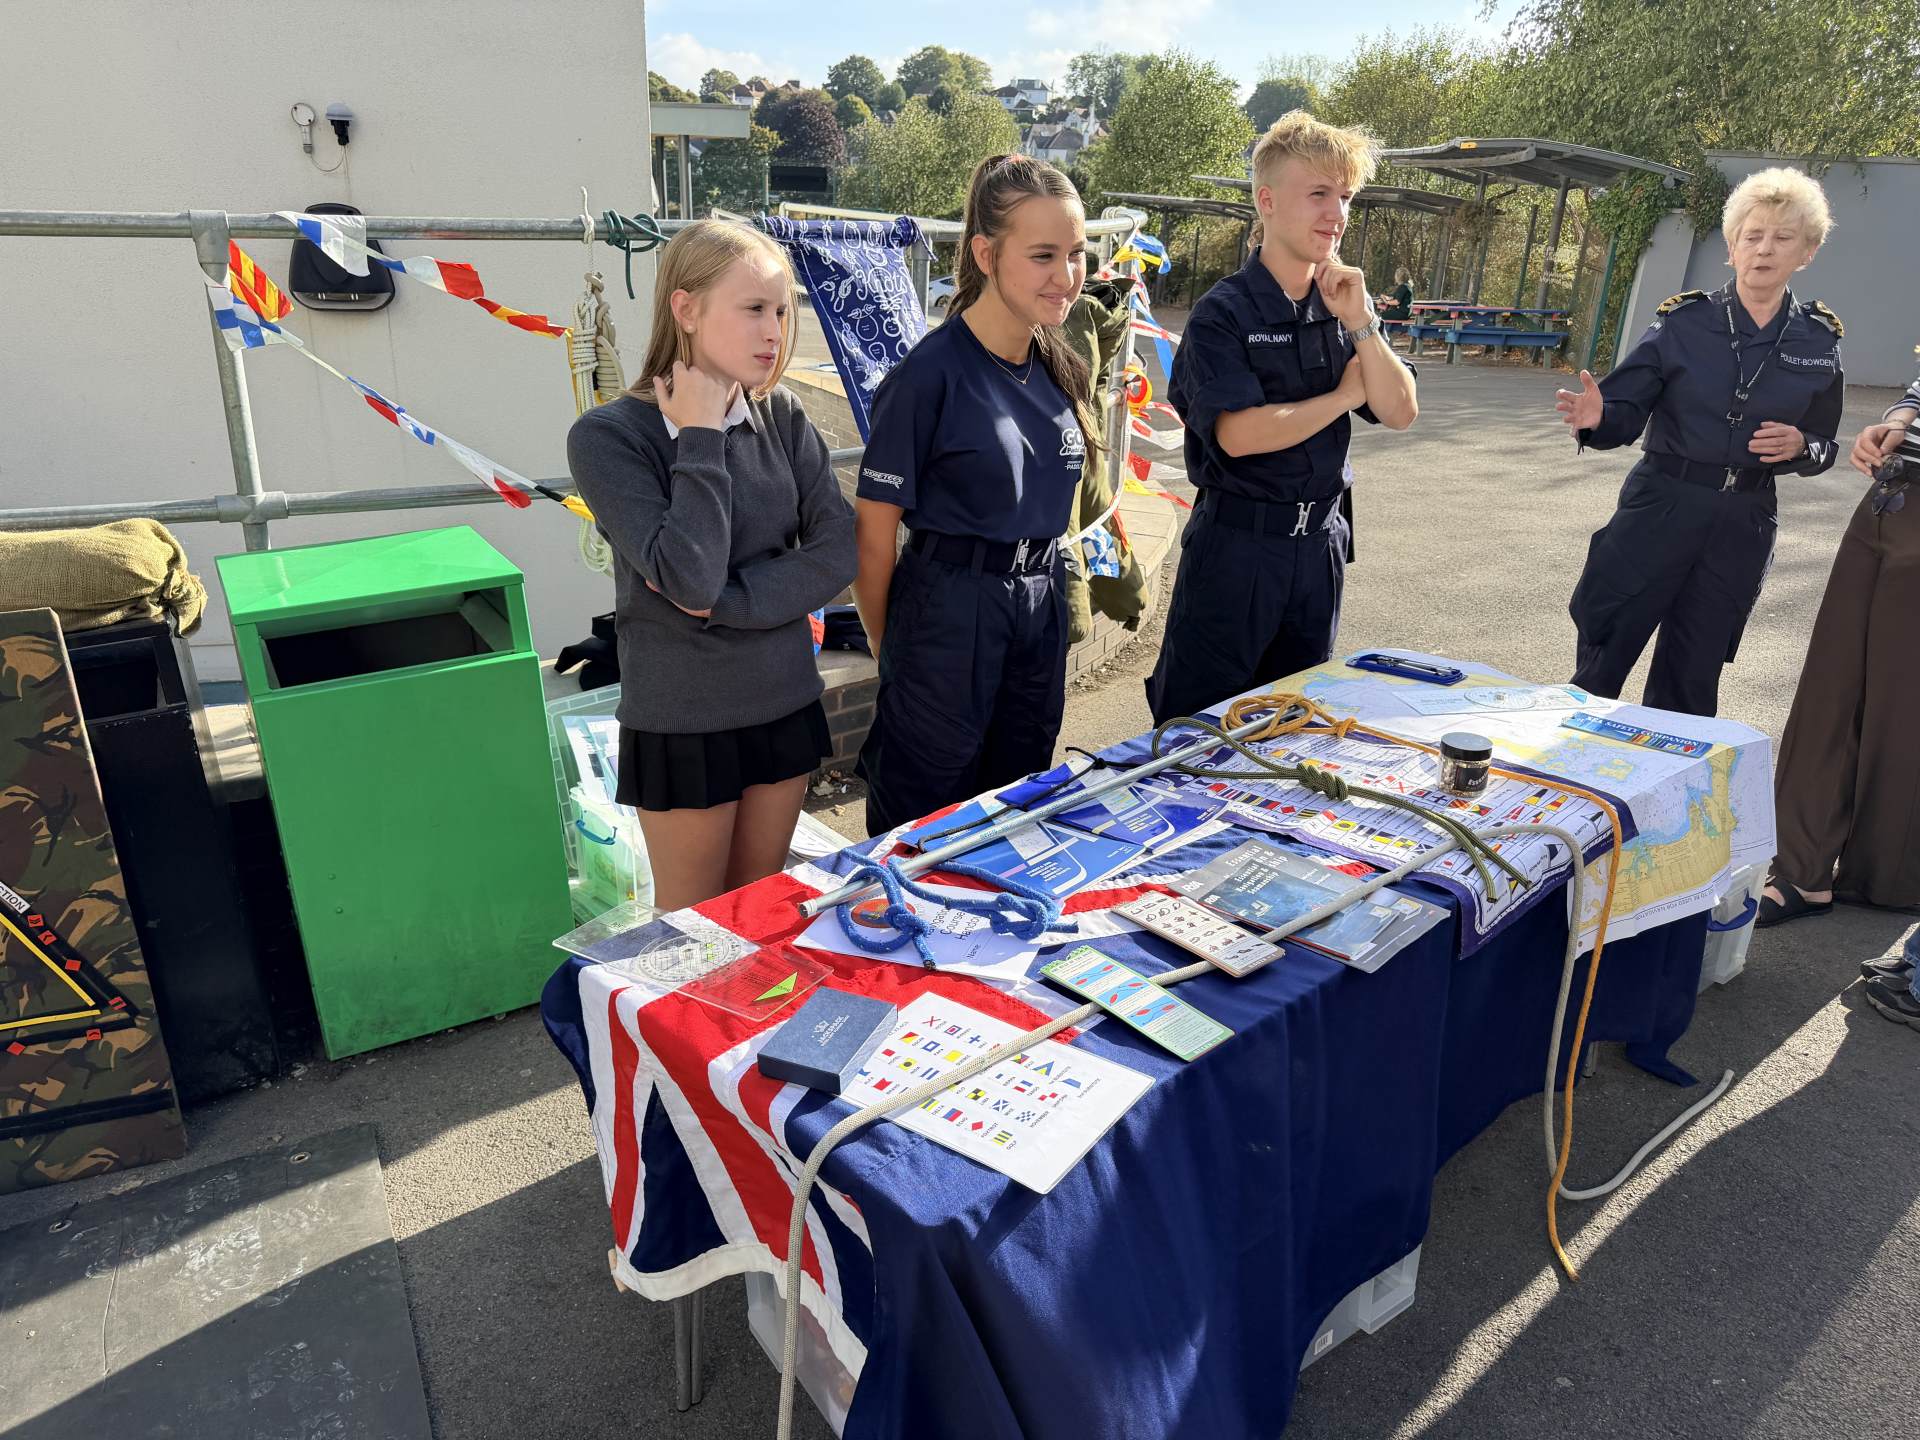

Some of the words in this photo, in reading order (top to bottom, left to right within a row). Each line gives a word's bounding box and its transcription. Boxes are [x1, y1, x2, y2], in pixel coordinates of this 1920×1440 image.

[1248, 334, 1273, 343] ROYAL
[1273, 333, 1293, 343] NAVY
[1605, 721, 1637, 733] SAFETY
[1640, 729, 1700, 746] COMPANION
[1225, 845, 1263, 867] Essential
[1234, 863, 1260, 882] Essential
[1234, 871, 1265, 893] Navigation
[1247, 871, 1280, 895] Seamanship
[940, 911, 966, 935] Course
